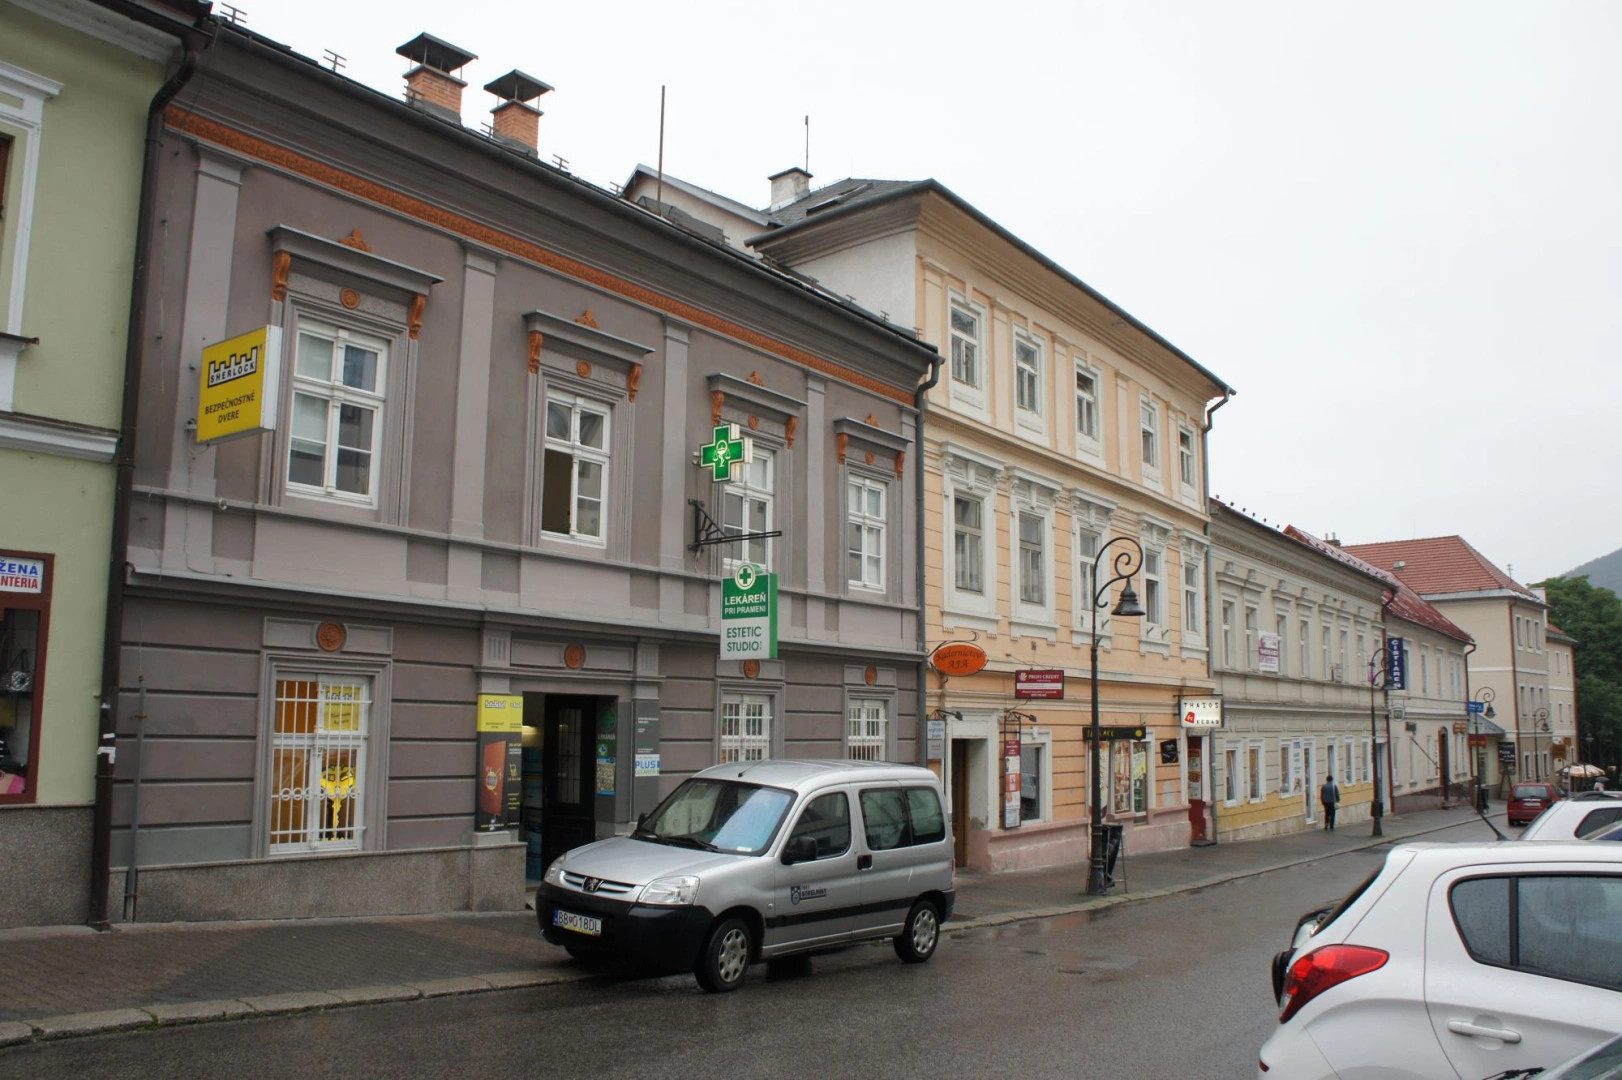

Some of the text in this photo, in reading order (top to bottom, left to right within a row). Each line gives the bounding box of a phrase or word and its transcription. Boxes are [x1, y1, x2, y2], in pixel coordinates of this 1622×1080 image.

[210, 361, 255, 383] SHERLOCK
[204, 390, 256, 415] BEZPEČNOSTNÉ
[217, 409, 240, 424] DVERE
[724, 592, 766, 605] LEKÁREŇ
[724, 605, 766, 615] PRI PRAMENI
[726, 626, 762, 639] ESTETIC
[726, 641, 759, 652] STUDIO
[635, 760, 656, 769] PLUS
